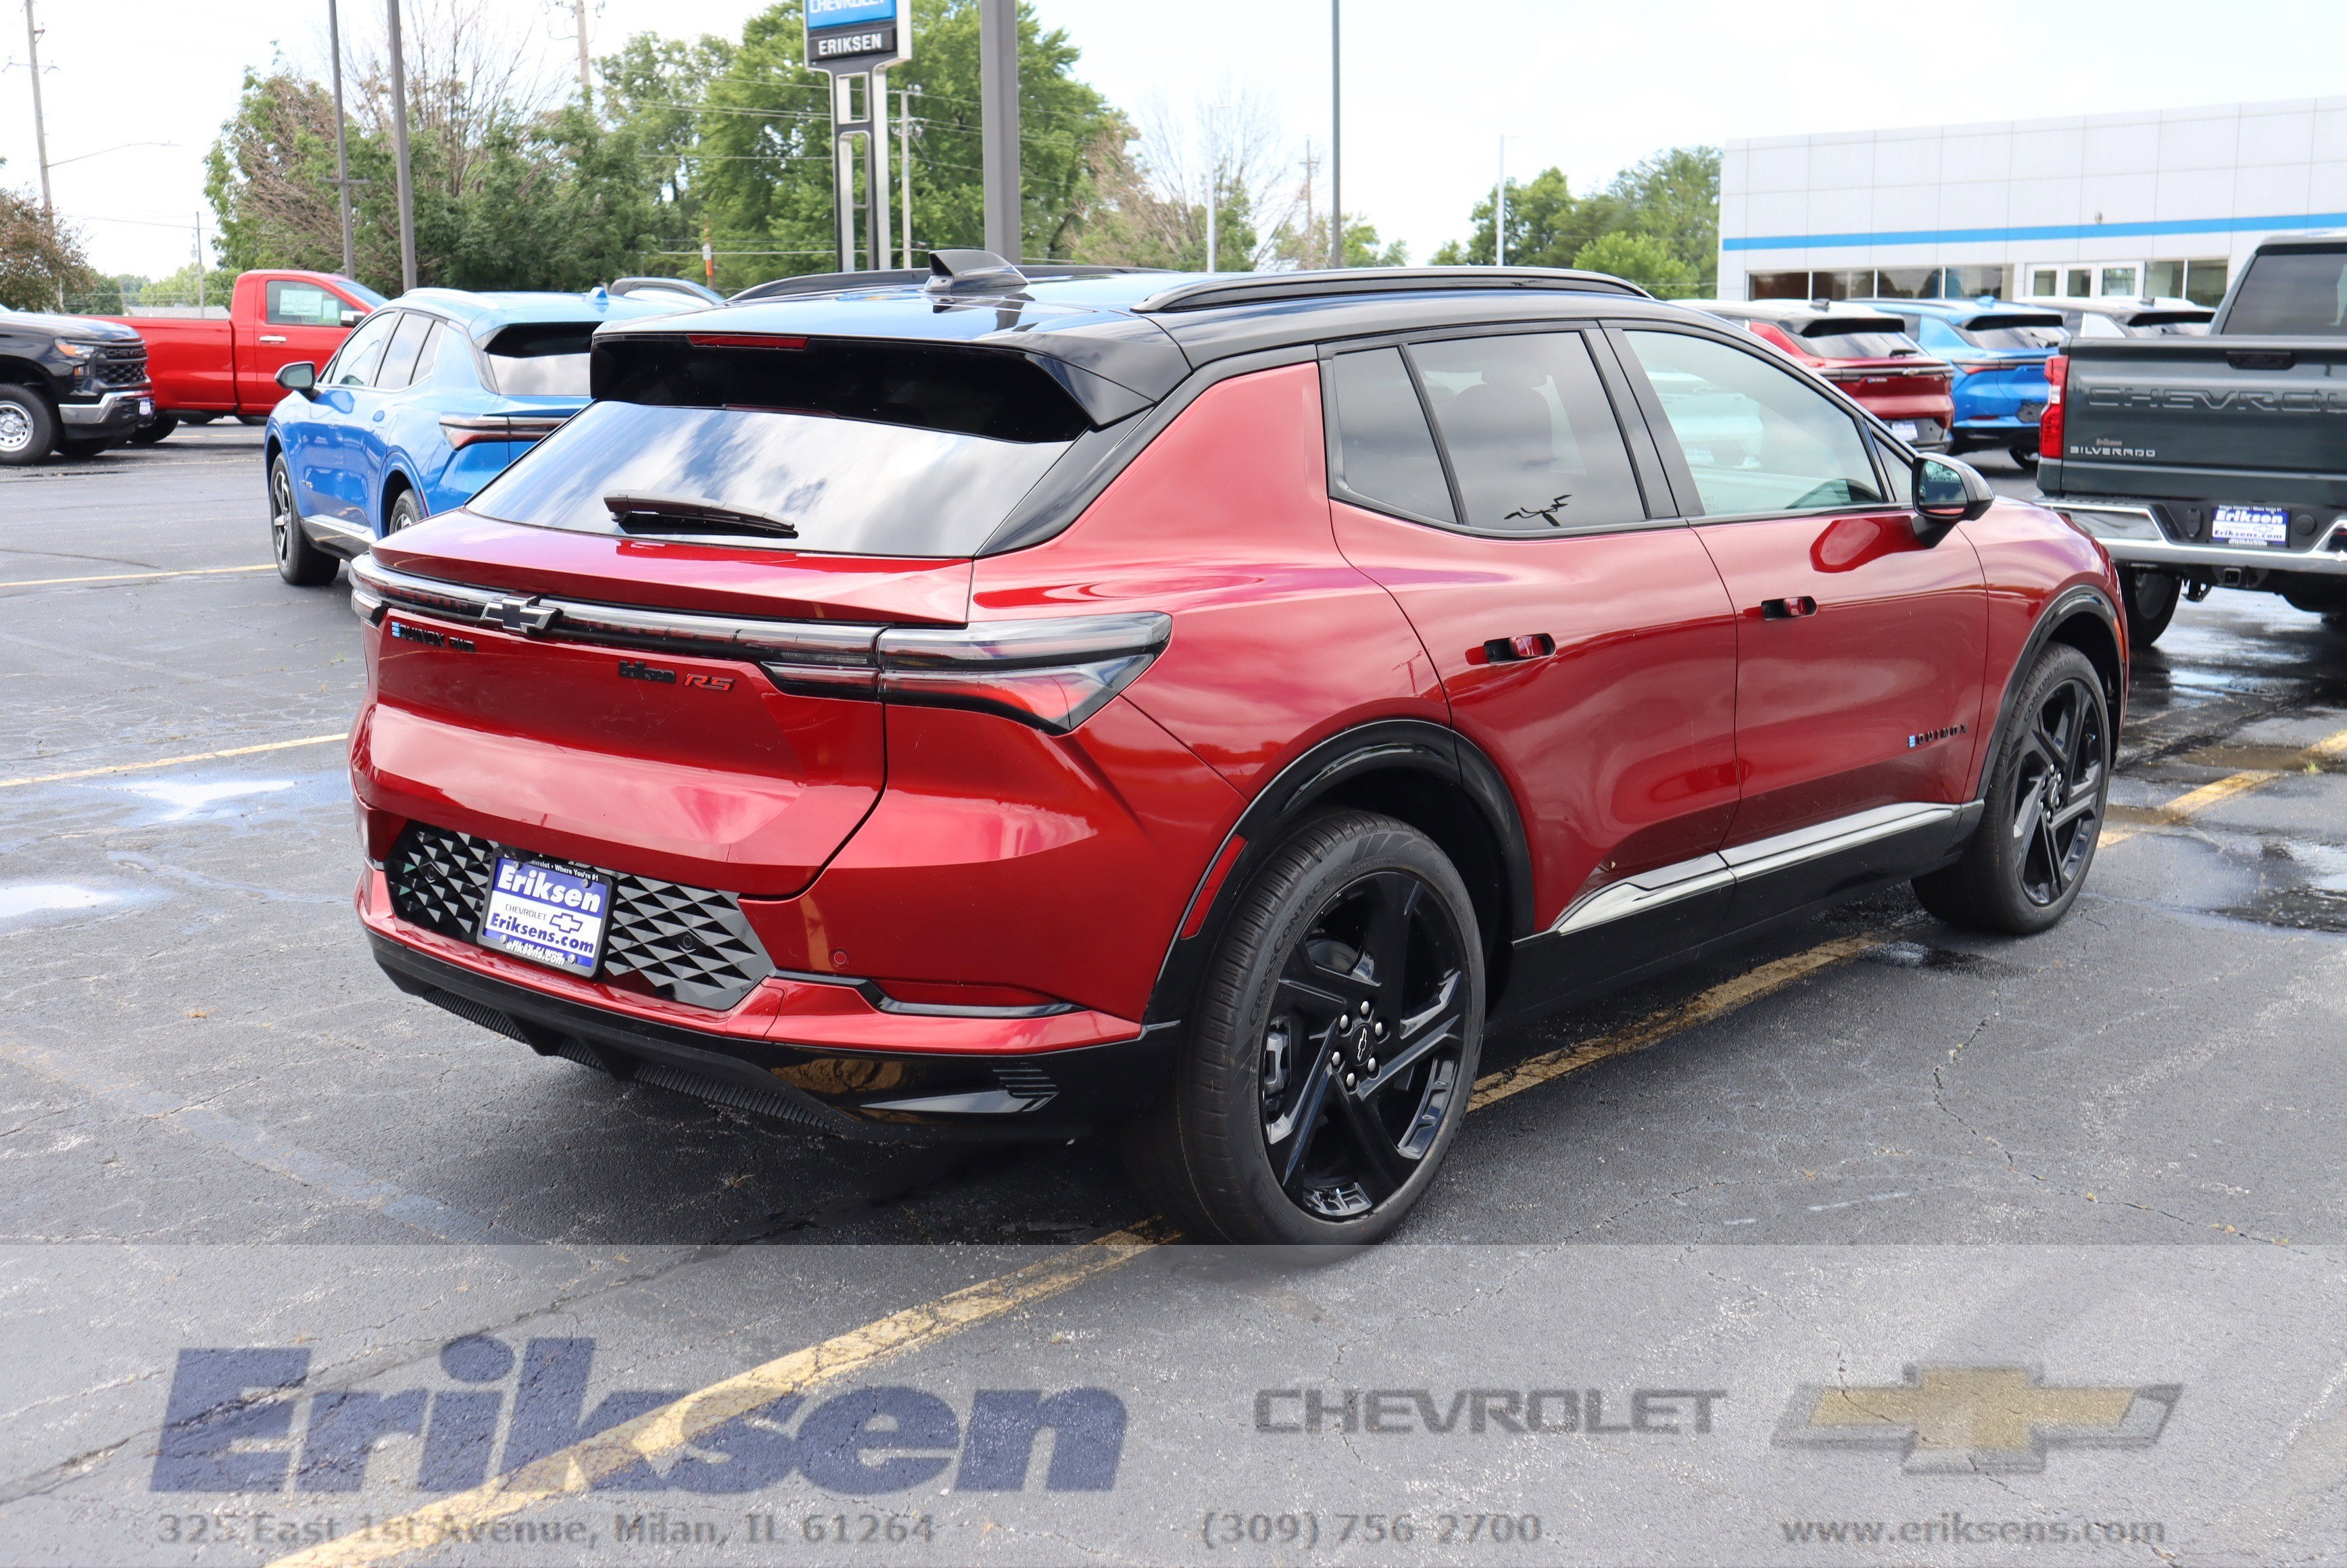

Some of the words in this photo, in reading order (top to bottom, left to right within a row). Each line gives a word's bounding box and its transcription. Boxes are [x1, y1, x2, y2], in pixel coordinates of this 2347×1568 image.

[810, 0, 885, 14] CHEVR
[818, 33, 882, 55] ERIKSEN
[2070, 445, 2156, 458] SILVERADO
[2215, 509, 2283, 524] Eriksen
[683, 673, 735, 691] RS
[554, 864, 573, 875] Where
[497, 864, 601, 912] Eriksen
[505, 904, 547, 921] CHEVROLET
[489, 912, 594, 954] Eriksens.com
